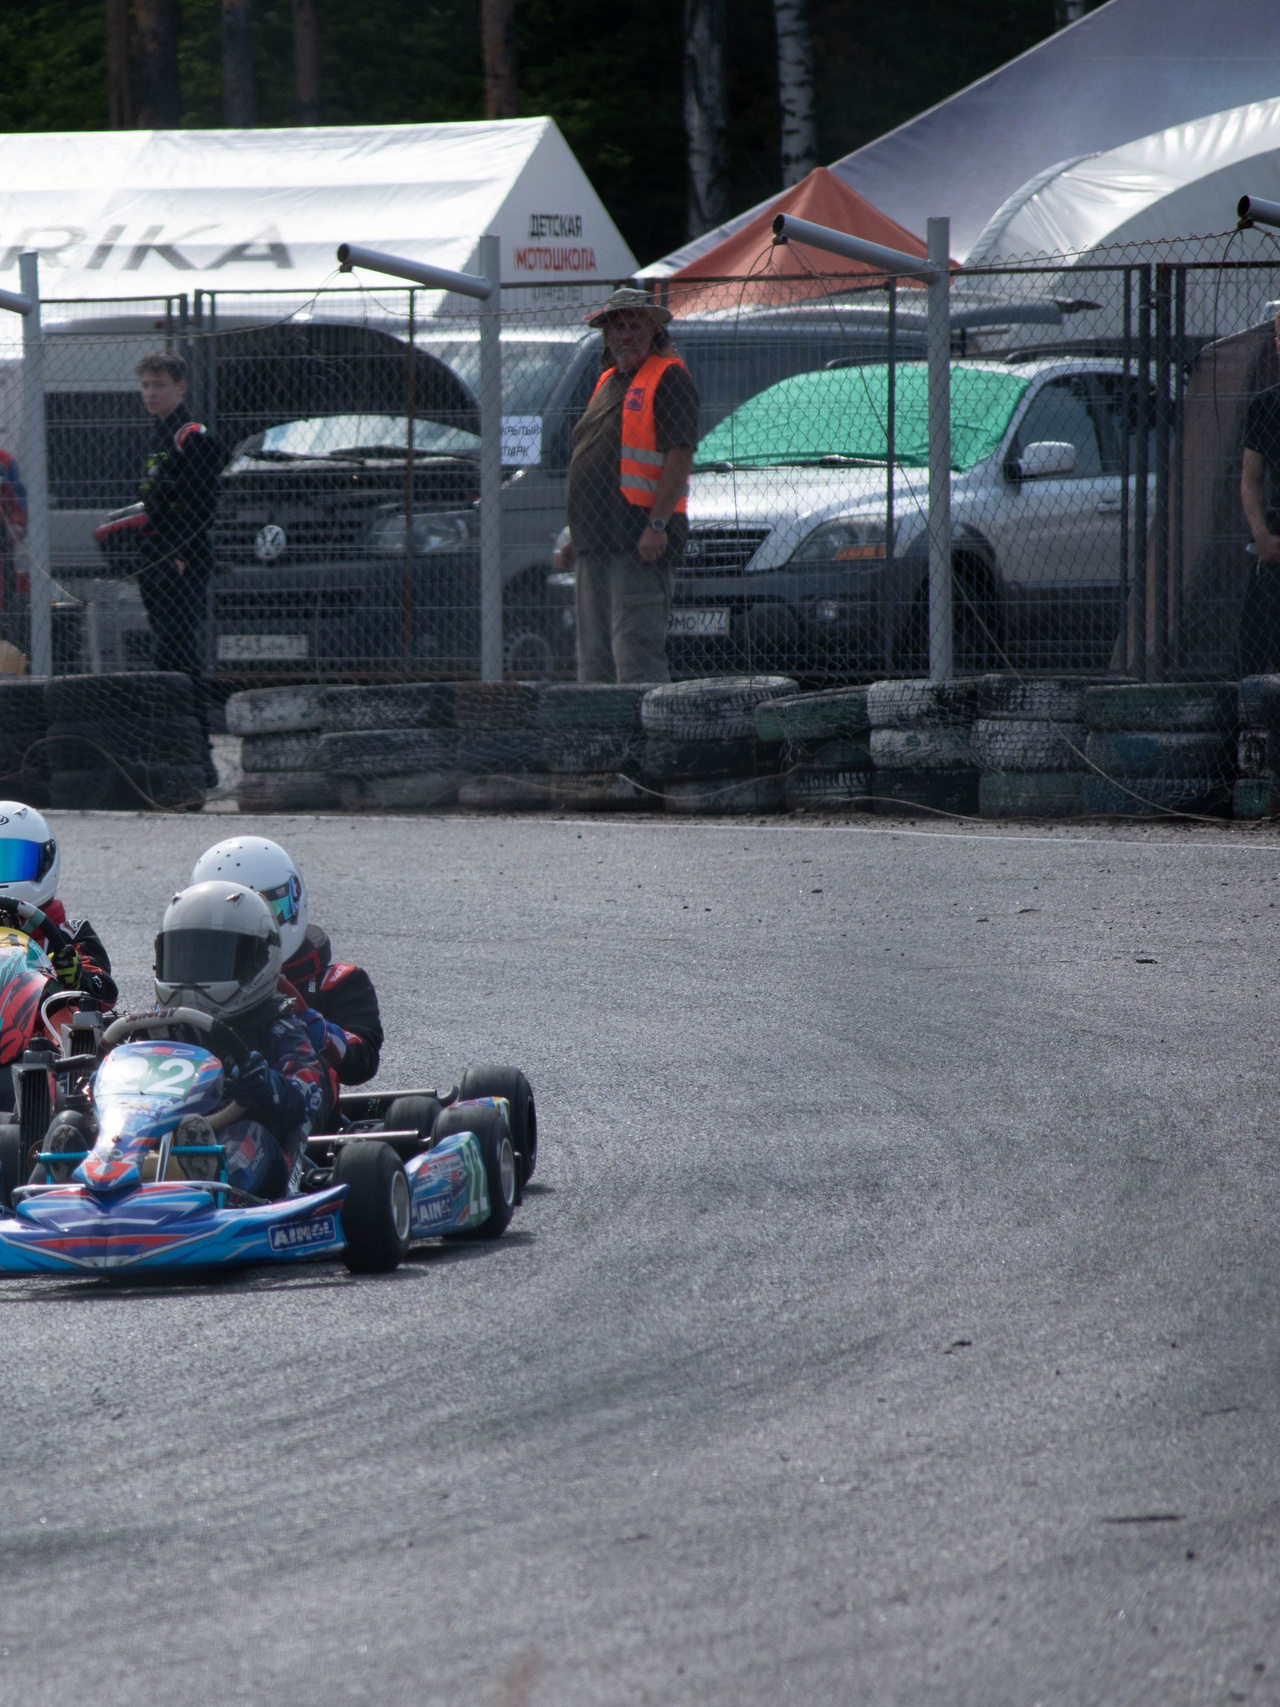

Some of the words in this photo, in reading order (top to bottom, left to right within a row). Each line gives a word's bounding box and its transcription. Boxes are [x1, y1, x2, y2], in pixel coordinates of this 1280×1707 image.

[530, 213, 582, 240] ДЕТСКАЯ
[514, 247, 597, 271] МОТОШКОЛА
[102, 1056, 195, 1096] 22
[461, 1139, 489, 1215] 22
[273, 1221, 333, 1247] AIMOL
